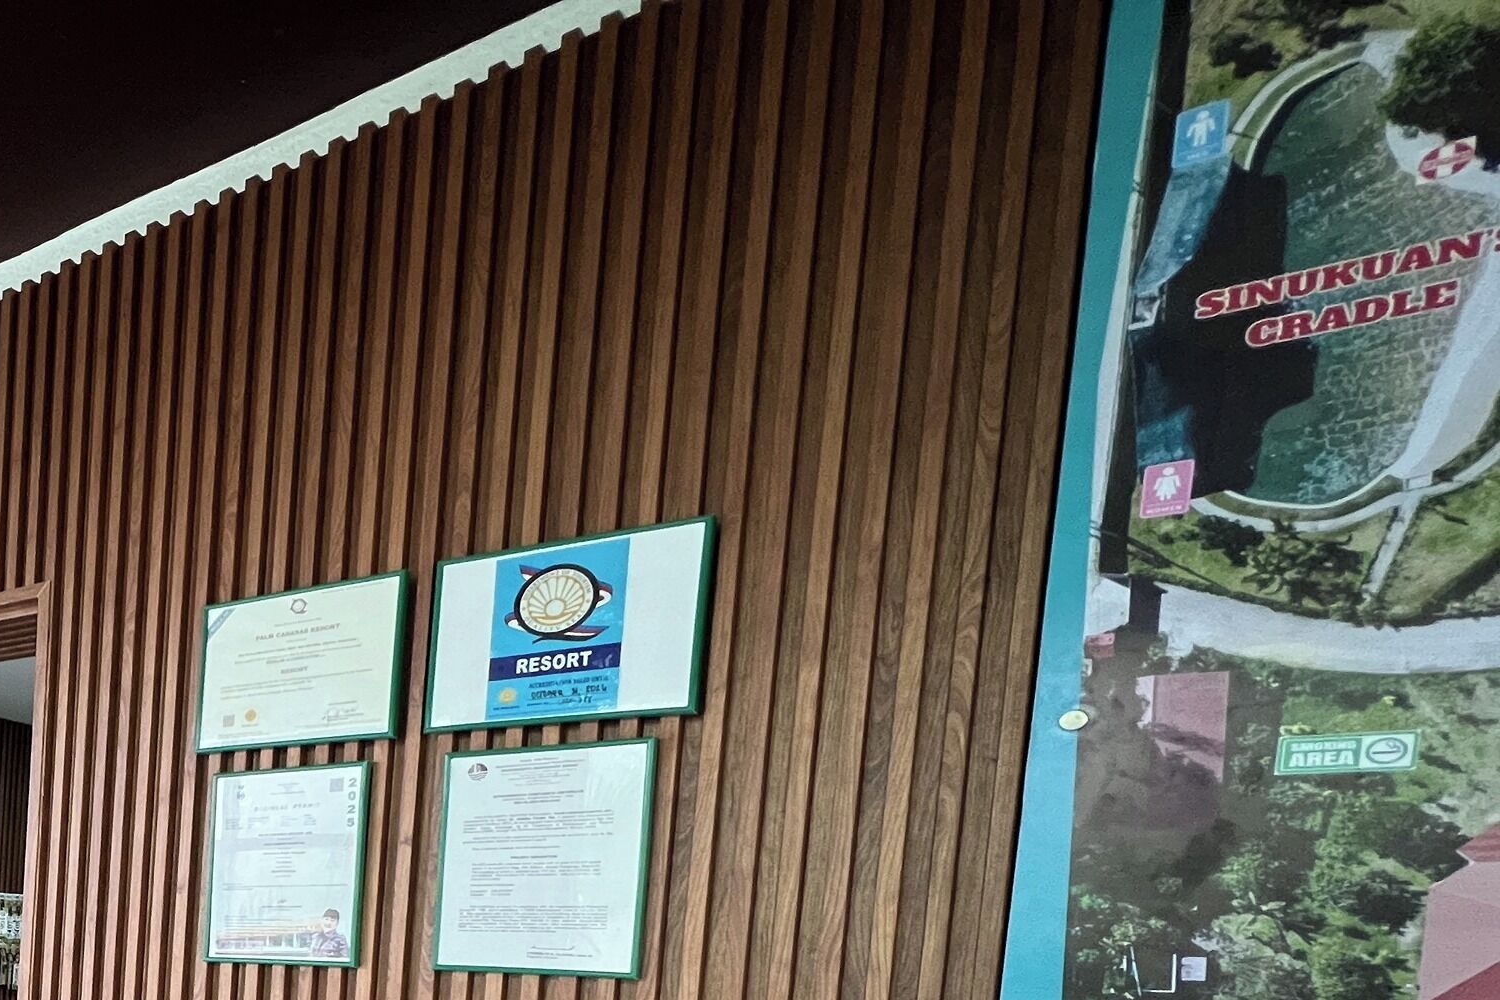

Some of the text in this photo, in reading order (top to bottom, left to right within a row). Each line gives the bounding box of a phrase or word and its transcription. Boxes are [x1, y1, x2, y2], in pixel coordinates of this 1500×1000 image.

[1245, 279, 1459, 347] CRADLE
[515, 650, 593, 675] RESORT
[1288, 750, 1355, 768] AREA
